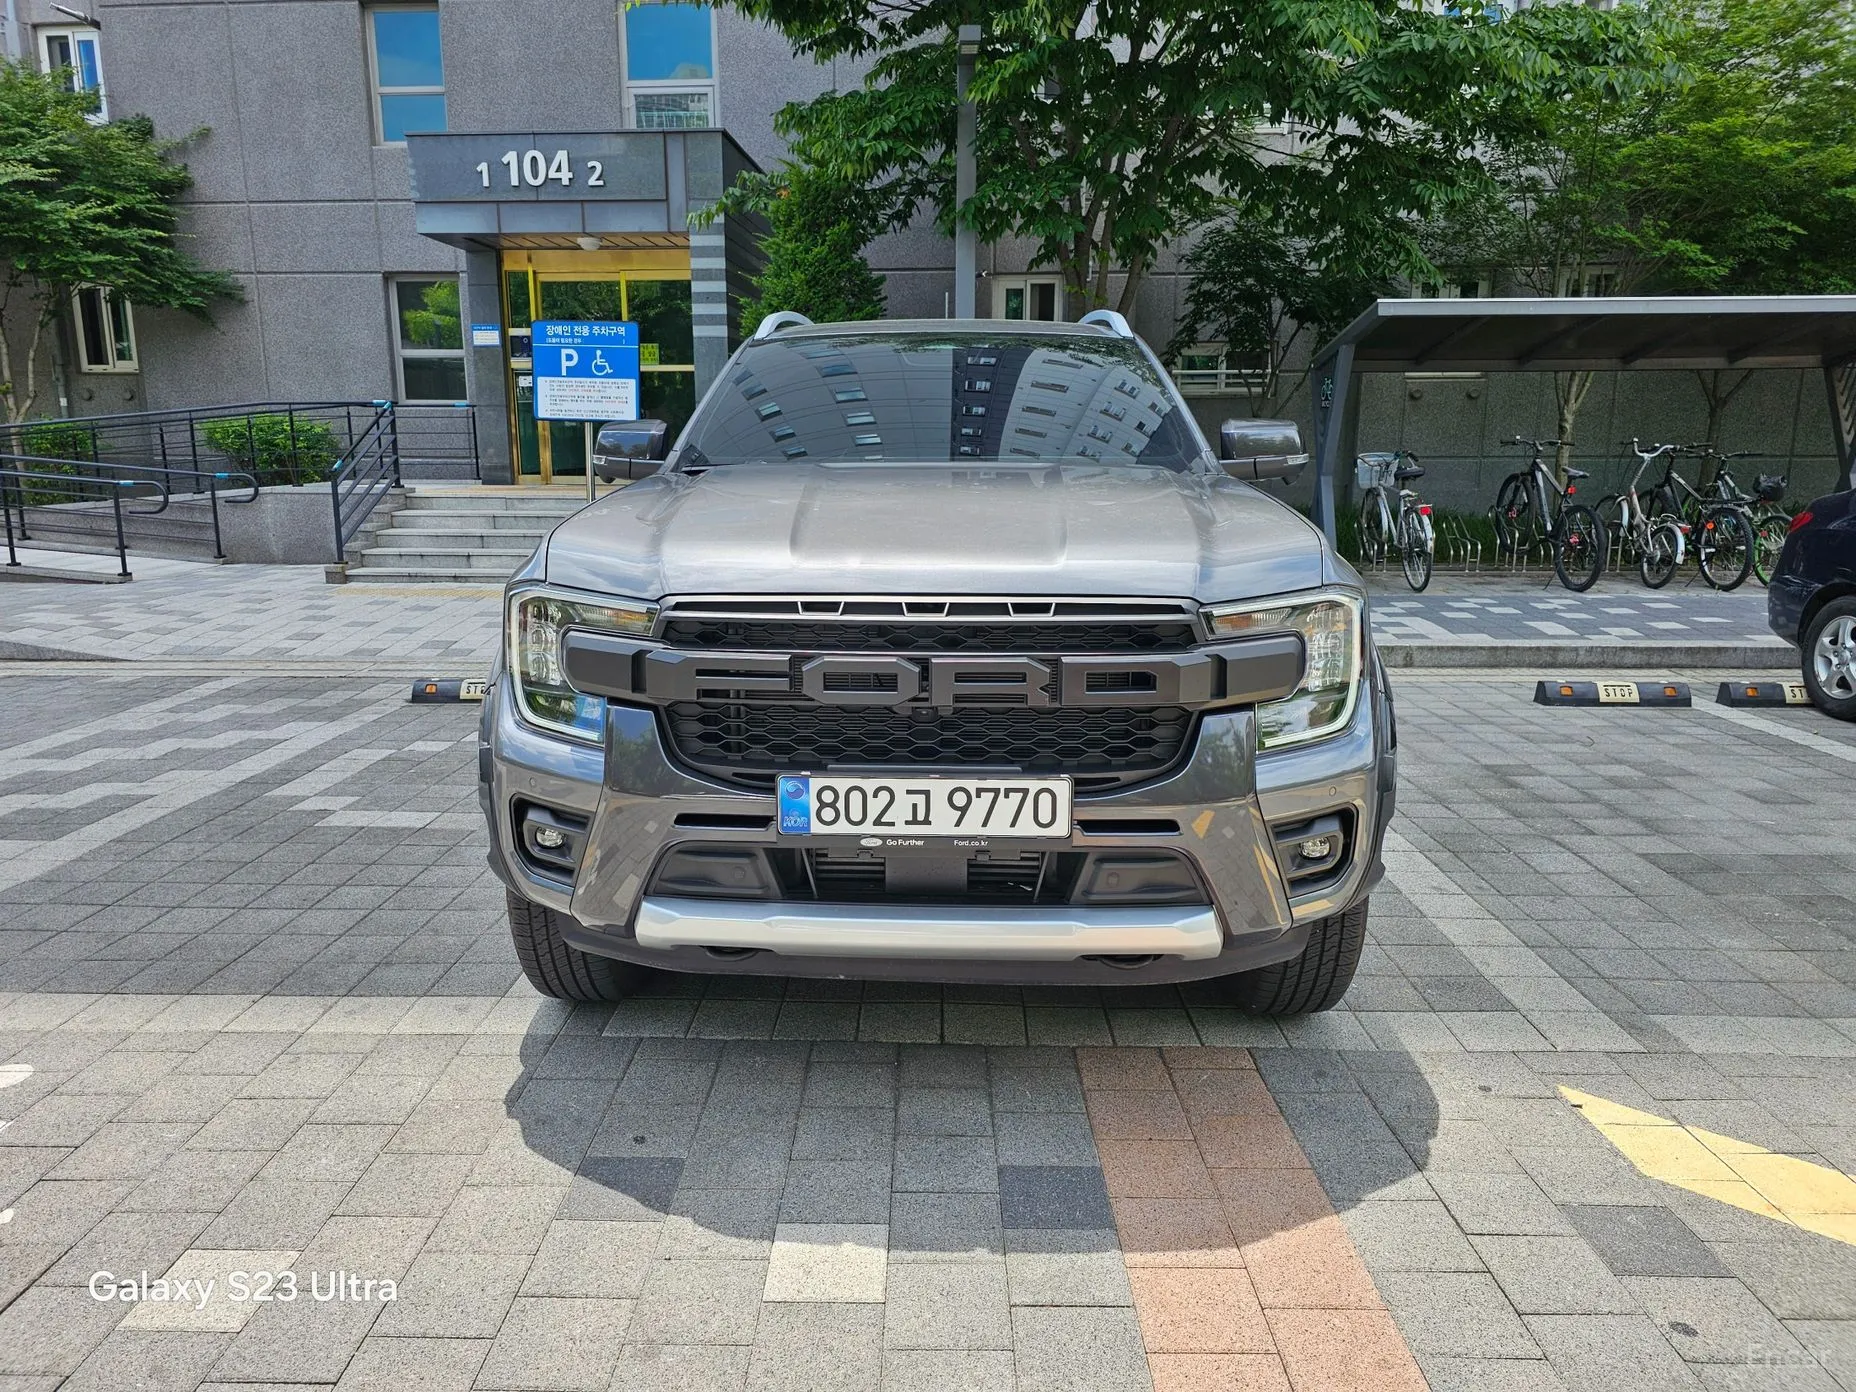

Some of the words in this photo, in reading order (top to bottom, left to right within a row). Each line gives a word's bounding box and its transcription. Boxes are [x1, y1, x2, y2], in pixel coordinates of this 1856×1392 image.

[476, 162, 490, 187] 1
[501, 149, 574, 187] 104
[587, 160, 604, 186] 2
[546, 325, 571, 336] 장애인
[573, 325, 590, 337] 전용
[592, 325, 626, 337] 주차구역
[561, 348, 579, 376] P
[1604, 687, 1633, 698] STOP
[886, 838, 897, 846] Go
[898, 838, 925, 846] Further
